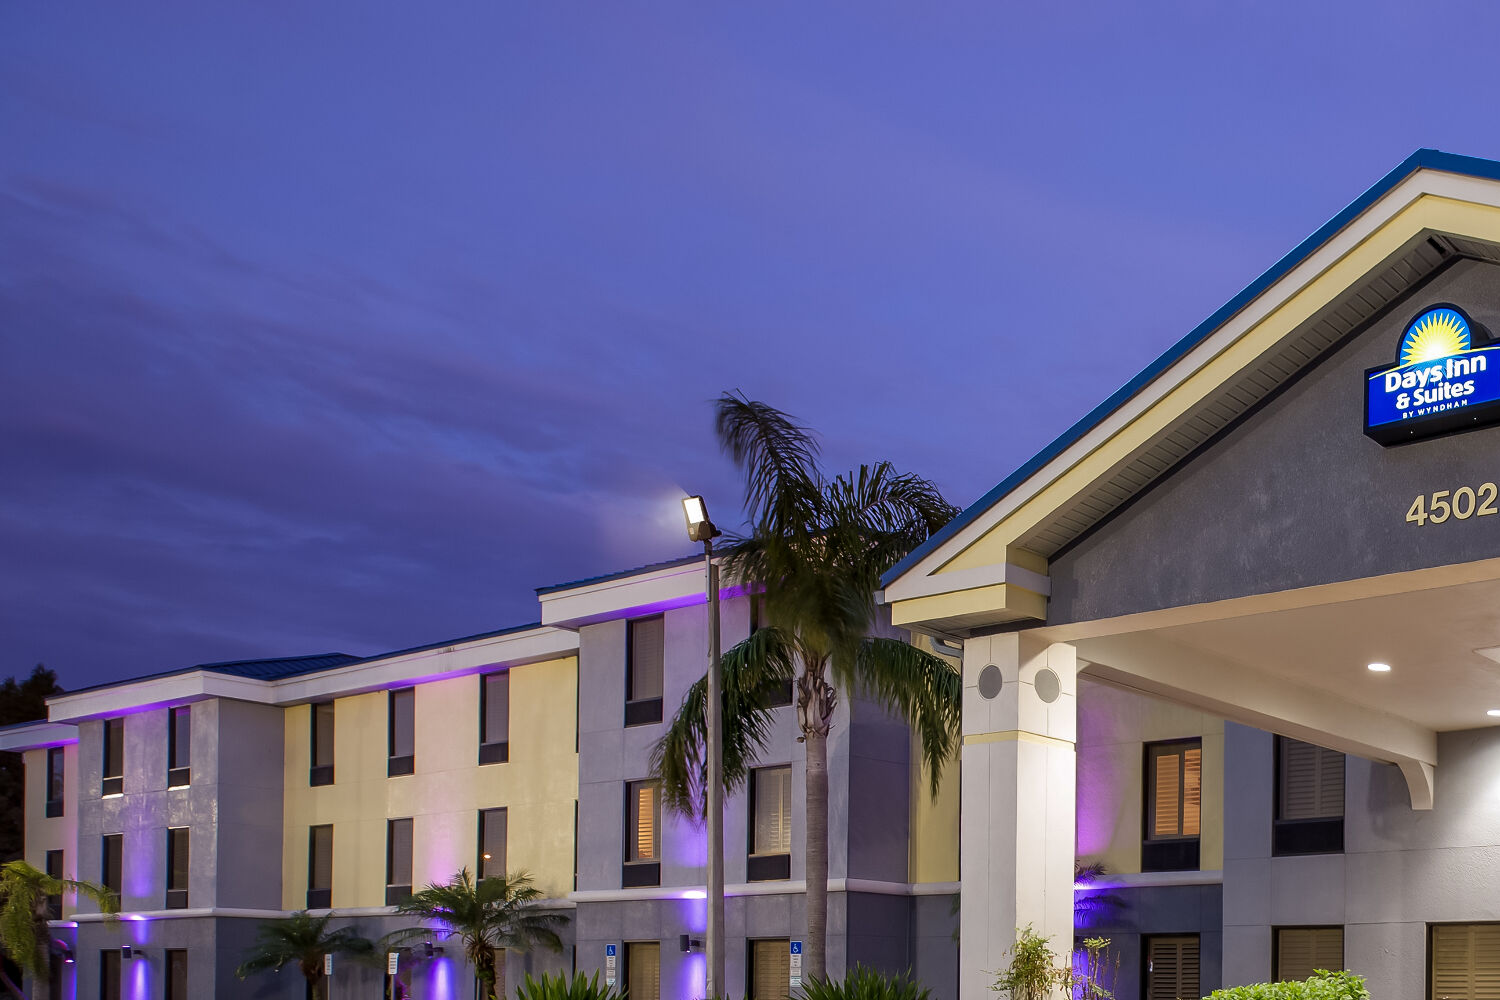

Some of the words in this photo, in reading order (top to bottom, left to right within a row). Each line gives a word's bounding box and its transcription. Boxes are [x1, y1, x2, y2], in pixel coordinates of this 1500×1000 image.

[1385, 365, 1443, 393] Days
[1446, 355, 1487, 379] Inn
[1395, 392, 1411, 410] &
[1413, 380, 1475, 406] Suites
[1402, 411, 1414, 419] BY
[1417, 399, 1468, 416] WYNDHAM
[1405, 482, 1499, 526] 4502
